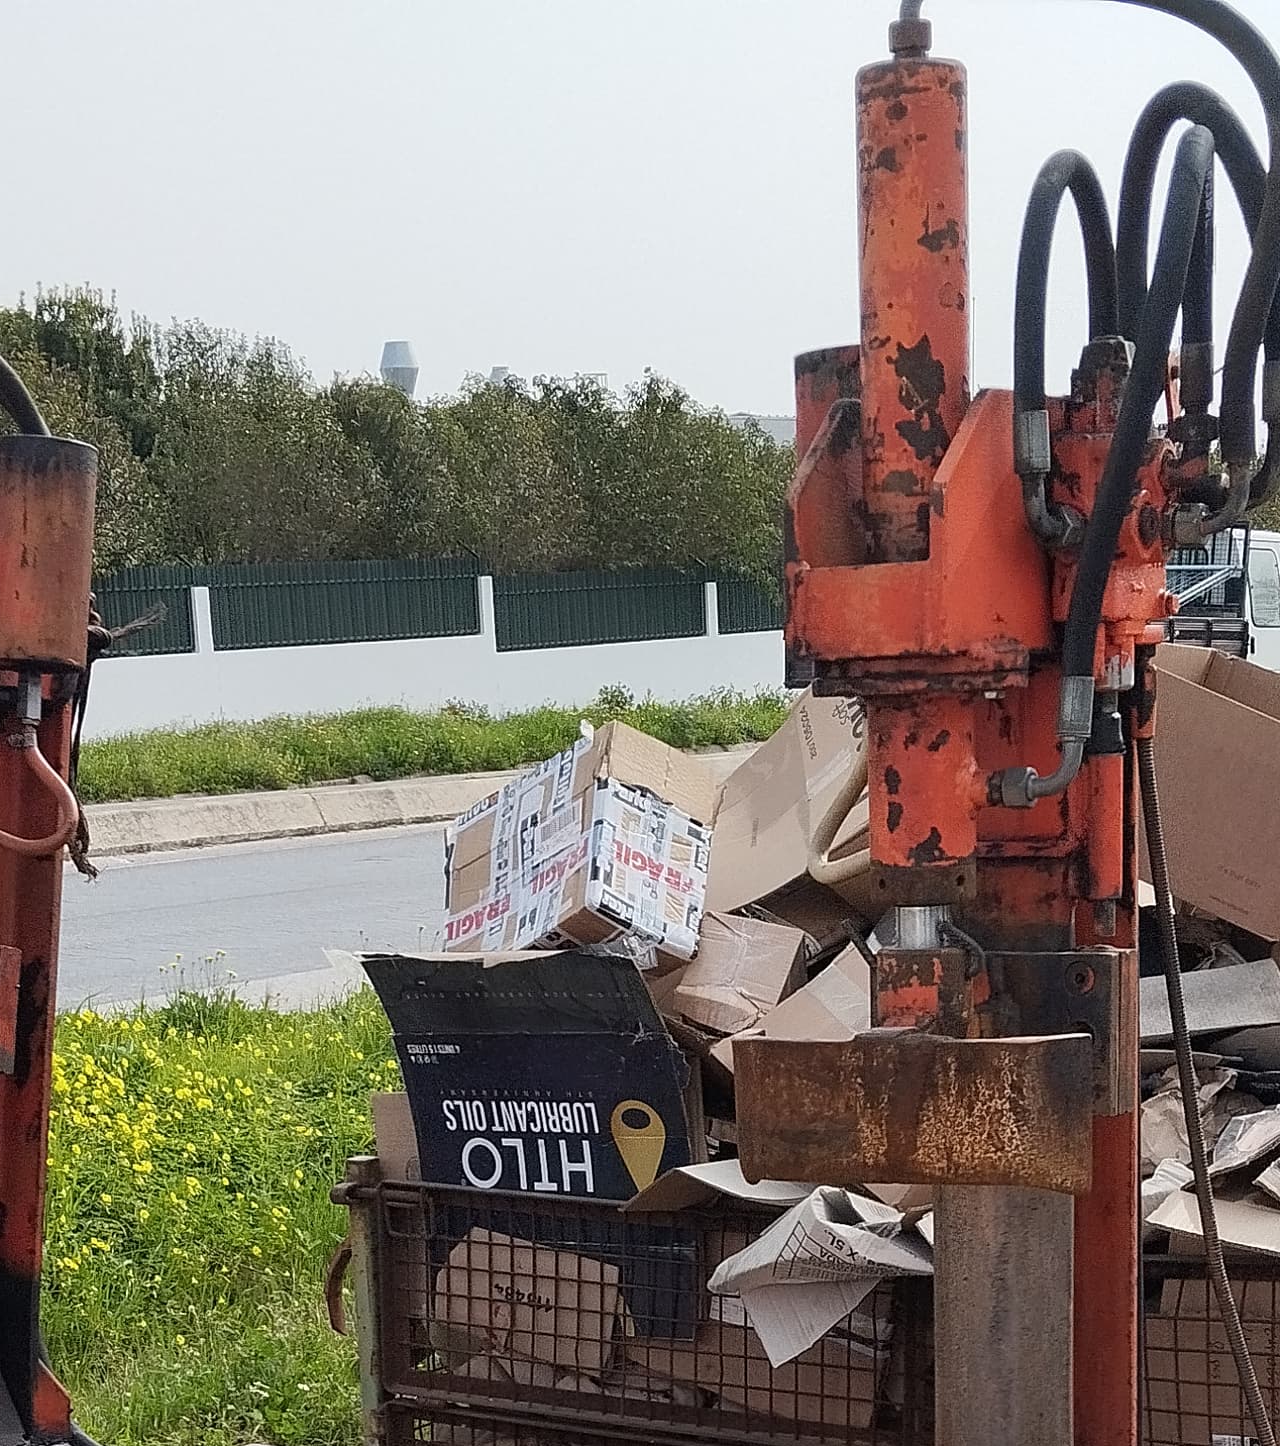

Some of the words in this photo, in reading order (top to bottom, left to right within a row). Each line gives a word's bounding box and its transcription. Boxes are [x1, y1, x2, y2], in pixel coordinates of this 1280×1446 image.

[442, 1100, 486, 1132] OILS
[490, 1102, 600, 1134] LUBRICANT
[462, 1137, 595, 1193] HTLO
